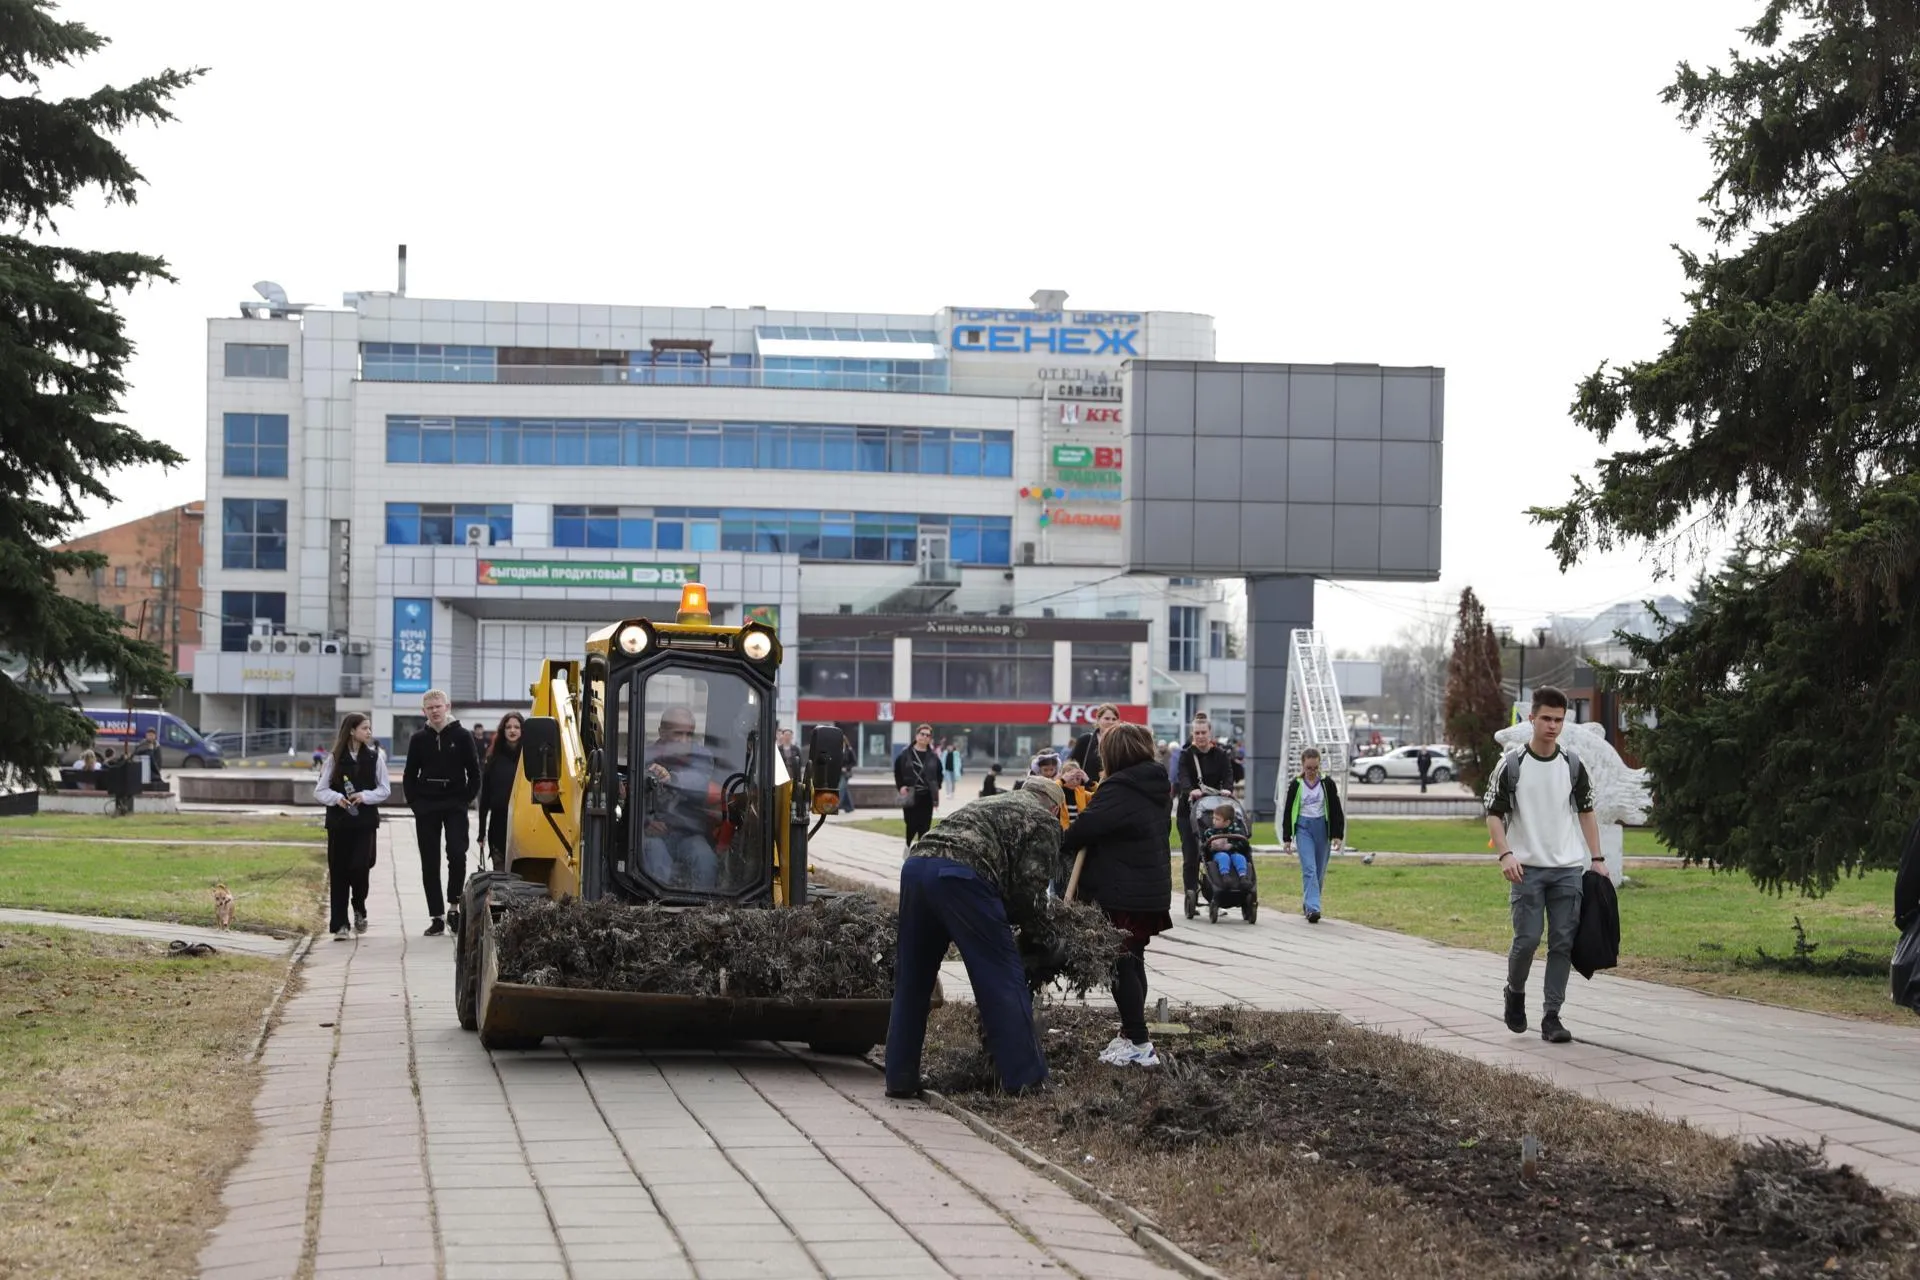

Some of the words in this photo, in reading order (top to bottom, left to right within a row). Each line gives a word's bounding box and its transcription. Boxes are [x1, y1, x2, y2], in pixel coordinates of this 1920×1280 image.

[956, 309, 1062, 323] ТОРГОВЫЙ
[1072, 312, 1141, 325] ЦЕНТР
[951, 325, 1139, 355] СЕНЕЖ
[1085, 408, 1122, 422] KFC
[489, 565, 549, 579] ВЫГОДНЫЙ
[551, 566, 628, 581] ПРОДУКТОВЫЙ
[926, 621, 1010, 635] Хинкальная
[400, 640, 426, 653] 124
[402, 653, 422, 666] 42
[403, 666, 421, 680] 92
[1049, 704, 1098, 723] KFC
